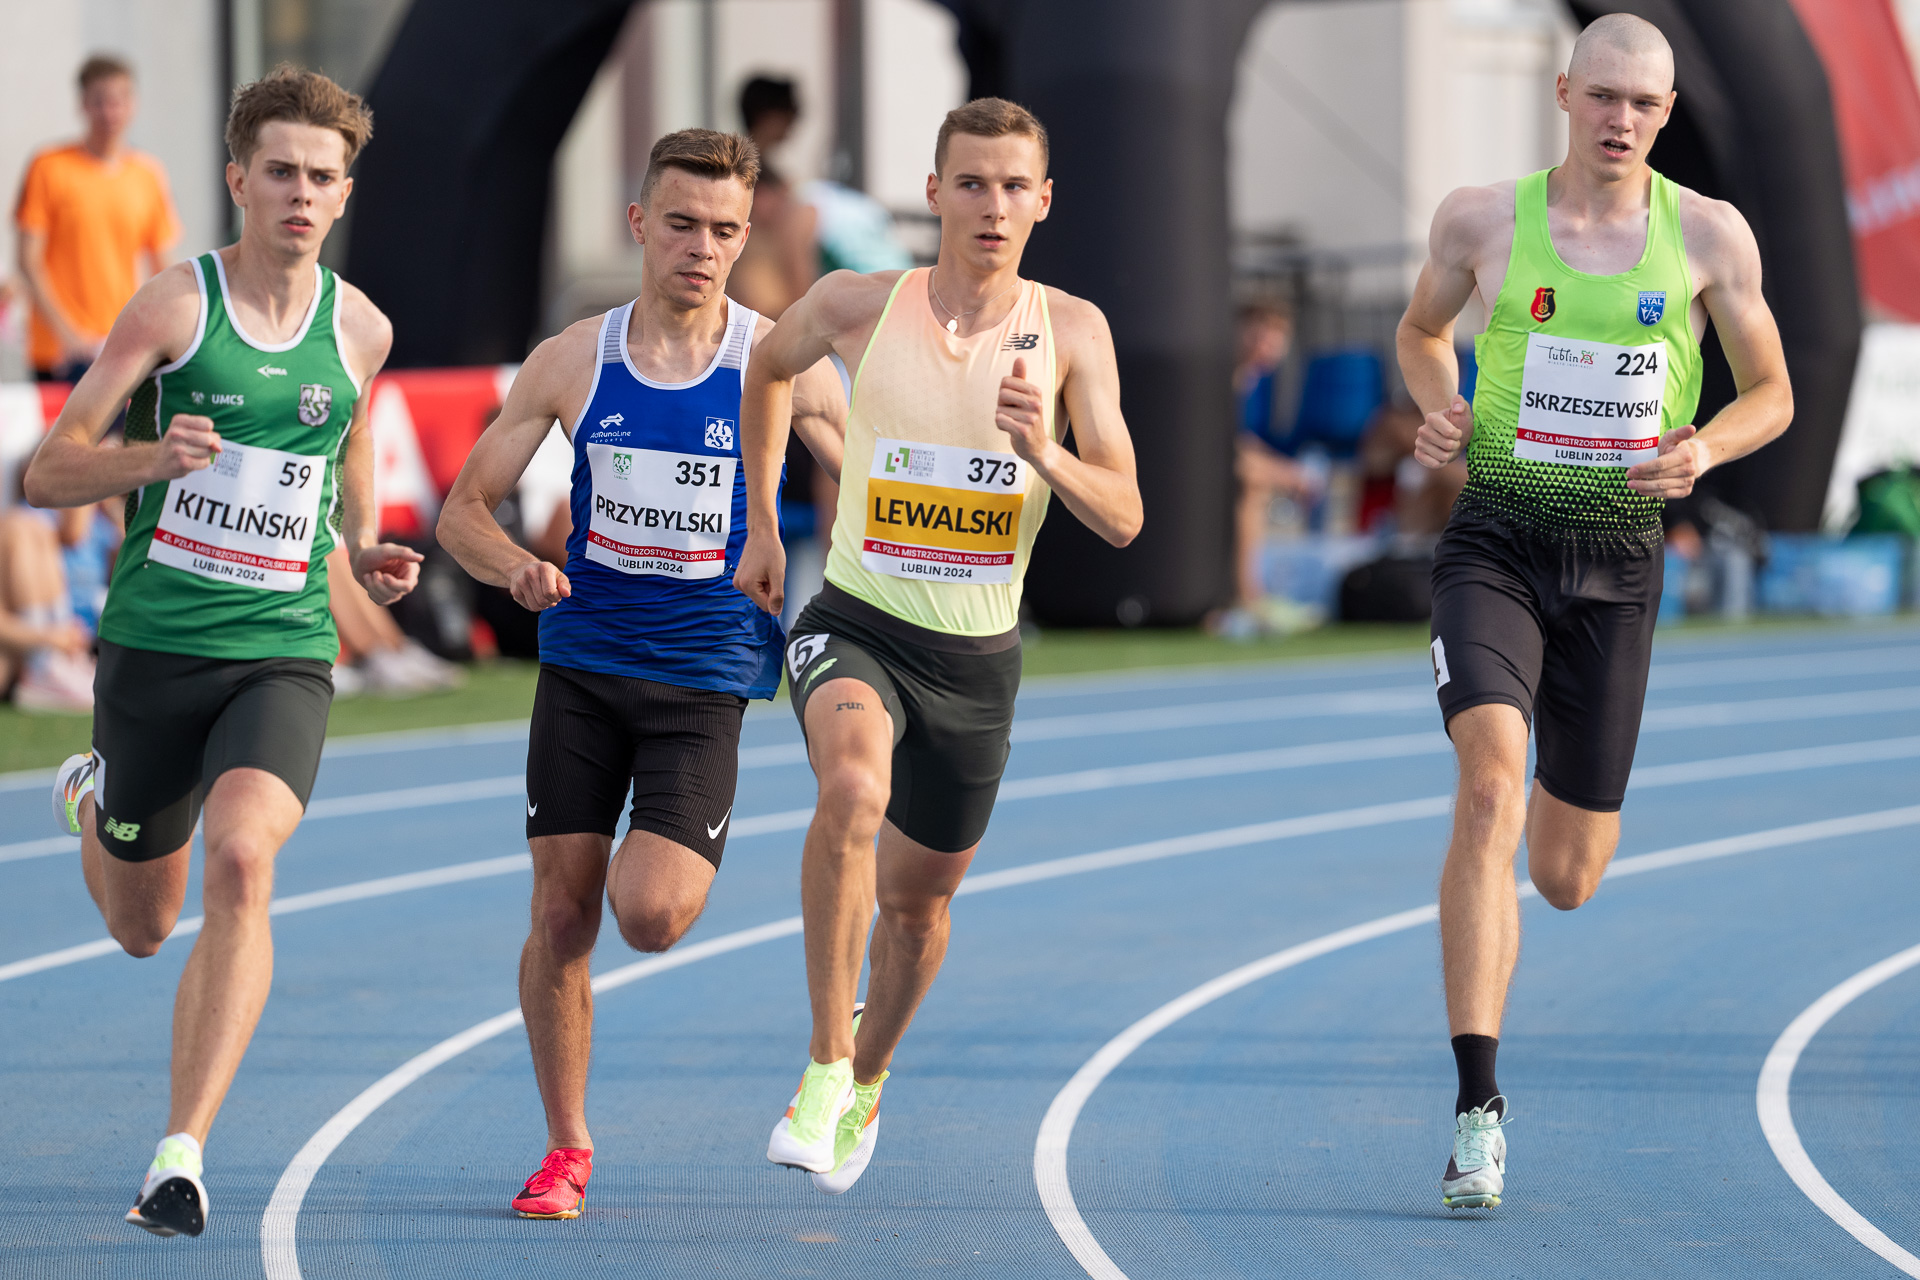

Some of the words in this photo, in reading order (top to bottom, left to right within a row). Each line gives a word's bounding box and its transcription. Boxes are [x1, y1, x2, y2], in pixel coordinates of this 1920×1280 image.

[1640, 297, 1663, 306] STAL
[1615, 352, 1657, 376] 224
[211, 394, 244, 406] UMCS
[1525, 390, 1659, 418] SKRZESZEWSKI
[1524, 431, 1534, 440] 41.
[1535, 434, 1554, 443] PZLA
[1555, 437, 1613, 448] MISTRZOSTWA
[1614, 441, 1641, 449] POLSKI
[1641, 440, 1653, 448] U23
[1555, 449, 1593, 461] LUBLIN
[1595, 452, 1622, 462] 2024
[278, 462, 312, 488] 59
[675, 461, 721, 487] 351
[967, 458, 1017, 486] 373
[174, 489, 307, 540] KITLIŃSKI
[596, 494, 723, 533] PRZYBYLSKI
[875, 497, 1013, 536] LEWALSKI
[174, 537, 194, 550] PZLA
[195, 542, 257, 565] MISTRZOSTWA
[258, 558, 286, 569] POLSKI
[286, 561, 301, 571] U23
[593, 535, 601, 545] 41.
[602, 539, 616, 550] PZLA
[617, 544, 673, 558] MISTRZOSTWA
[675, 552, 701, 560] POLSKI
[871, 543, 882, 552] 41.
[883, 546, 900, 555] PZLA
[901, 548, 963, 563] MISTRZOSTWA
[964, 555, 992, 564] POLSKI
[993, 556, 1007, 564] U23
[193, 558, 233, 576] LUBLIN
[235, 568, 265, 582] 2024
[617, 557, 653, 569] LUBLIN
[656, 561, 684, 574] 2024
[901, 562, 941, 576] LUBLIN
[944, 567, 972, 578] 2024
[794, 635, 815, 673] 5
[836, 702, 864, 711] run
